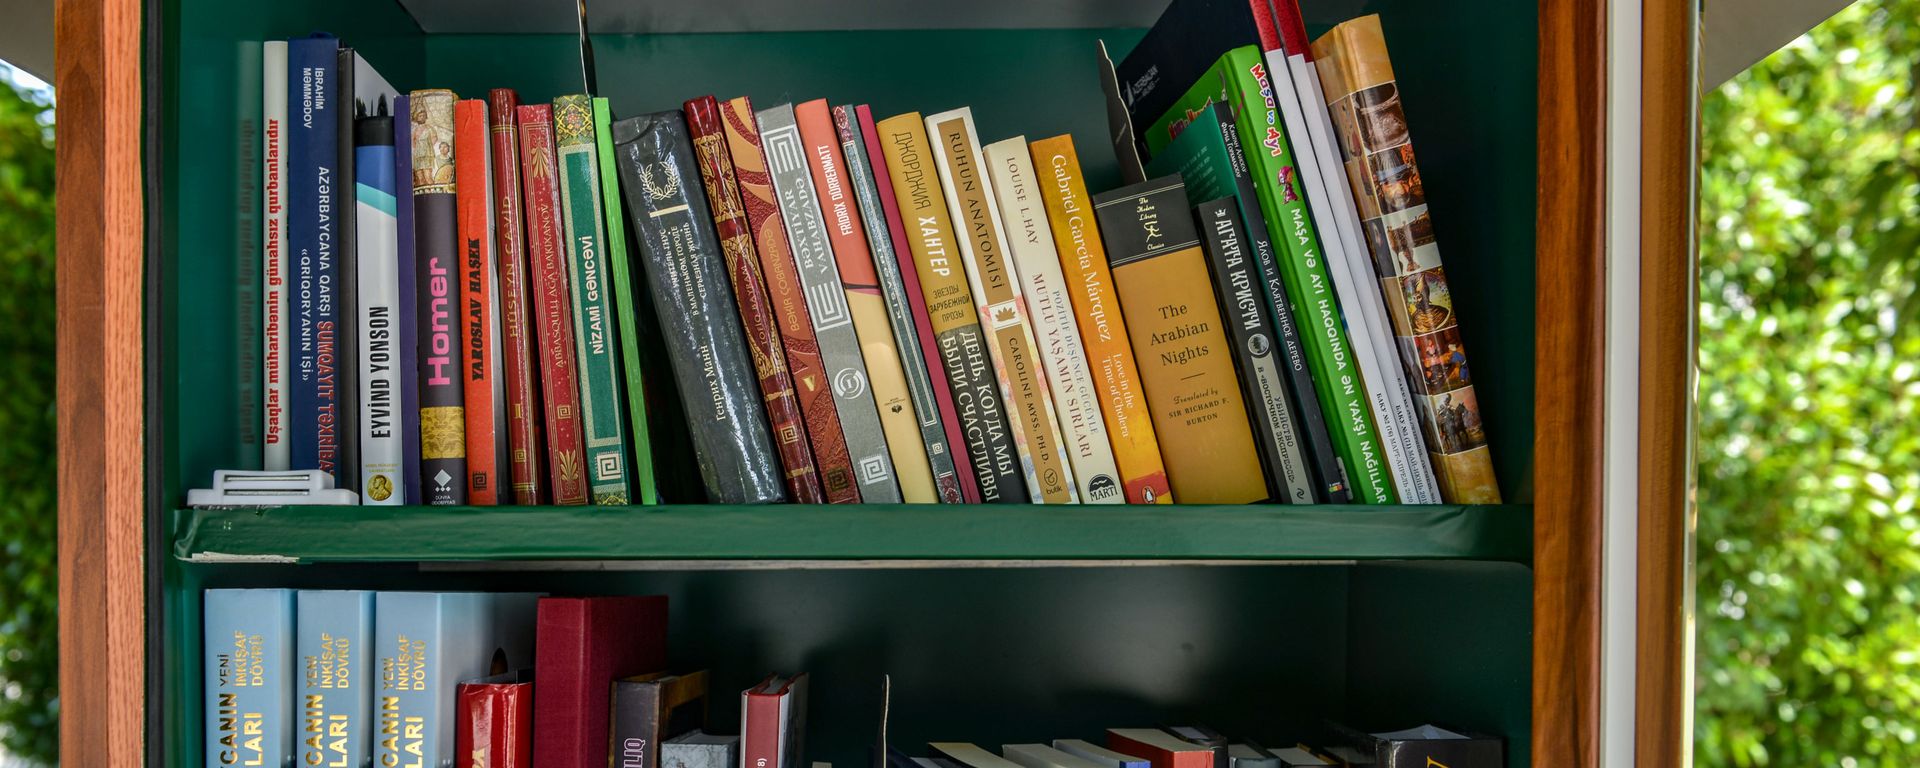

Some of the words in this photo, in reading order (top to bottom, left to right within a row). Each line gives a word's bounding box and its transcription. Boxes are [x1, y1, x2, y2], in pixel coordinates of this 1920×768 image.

[303, 67, 312, 129] MƏMMƏDOV
[314, 67, 325, 110] İBRAHİM
[1249, 63, 1277, 109] Maşa
[1263, 126, 1282, 157] Ayı
[266, 119, 280, 213] qurbanlarıdır
[817, 145, 843, 200] DÜRRENMATT
[1006, 157, 1026, 201] LOUISE
[318, 167, 330, 270] AZƏRBAYCANA
[784, 189, 814, 268] BƏXTİYAR
[795, 177, 828, 273] VAHABZADƏ
[834, 202, 853, 235] FRİDRİX
[892, 132, 931, 210] ДЖОРДЖИЯ
[918, 217, 950, 276] ХАНТЕР
[949, 132, 975, 192] RUHUN
[968, 199, 1004, 289] ANATOMİSİ
[266, 219, 282, 285] günahsız
[540, 203, 554, 269] BAKIXANOV
[1052, 154, 1080, 213] Gabriel
[1068, 216, 1093, 270] García
[1083, 272, 1112, 342] Márquez
[468, 238, 482, 293] HAŞEK
[579, 235, 598, 301] GƏNCƏVİ
[932, 284, 960, 299] ЗВЕЗДЫ
[1215, 219, 1243, 268] АГАТА
[1230, 270, 1261, 330] КРИСТИ
[317, 275, 331, 316] QARŞI
[428, 257, 450, 385] Homer
[928, 293, 971, 314] ЗАРУБЕЖНОЙ
[941, 310, 965, 323] ПРОЗЫ
[1158, 304, 1188, 319] The
[266, 291, 279, 383] müharibənin
[369, 306, 390, 373] YONSON
[470, 299, 484, 380] YAROSLAV
[550, 299, 566, 367] ABBASQULU
[585, 305, 604, 354] NİZAMİ
[1052, 290, 1070, 330] POZİTİF
[1064, 335, 1084, 384] DÜŞÜNCE
[1151, 322, 1209, 346] Arabian
[1161, 346, 1209, 366] Nights
[1290, 208, 1309, 246] MAŞA
[1303, 249, 1316, 269] VƏ
[1310, 274, 1324, 294] AYI
[1318, 299, 1346, 371] HAQQINDA
[1340, 375, 1354, 395] ƏN
[1348, 399, 1366, 436] YAXŞI
[1360, 441, 1386, 503] NAĞILLAR
[316, 321, 333, 399] SUMQAYIT
[700, 345, 715, 377] Манн
[1033, 273, 1054, 321] MUTLU
[1048, 328, 1074, 393] YAŞAMIN
[1067, 398, 1092, 458] SIRLARI
[1102, 356, 1114, 384] Time
[1112, 353, 1125, 378] Love
[1119, 379, 1129, 391] in
[266, 388, 281, 444] Uşaqlar
[368, 379, 391, 438] EYVİND
[709, 379, 726, 421] Генрих
[942, 335, 968, 389] БЫЛИ
[958, 392, 999, 500] СЧАСТЛИВЫ
[959, 332, 985, 382] ДЕНЬ,
[976, 384, 1003, 442] КОГДА
[993, 444, 1014, 476] МЫ
[1009, 337, 1033, 399] CAROLINE
[1026, 403, 1040, 432] MYSS,
[1036, 435, 1049, 465] PH.D.
[1110, 385, 1120, 396] of
[1113, 396, 1129, 437] Cholera
[1123, 391, 1134, 408] the
[1168, 410, 1182, 419] SIR
[1184, 400, 1220, 414] RICHARD
[1221, 397, 1230, 405] F.
[1173, 388, 1209, 405] Translated
[1210, 387, 1219, 396] by
[1376, 393, 1387, 412] БАКУ
[1395, 405, 1405, 424] БАКУ
[317, 403, 336, 475] TƏXRİBA
[1186, 412, 1218, 426] BURTON
[1274, 396, 1294, 447] УБИЙСТВО
[217, 654, 229, 687] YENİ
[234, 631, 248, 687] İNKİŞAF
[250, 635, 264, 686] DÖVRÜ
[304, 655, 318, 688] YENİ
[319, 633, 335, 688] İNKİŞAF
[335, 638, 349, 688] DÖVRÜ
[383, 657, 394, 690] YENİ
[396, 636, 411, 690] İNKİŞAF
[411, 640, 425, 690] DÖVRÜ
